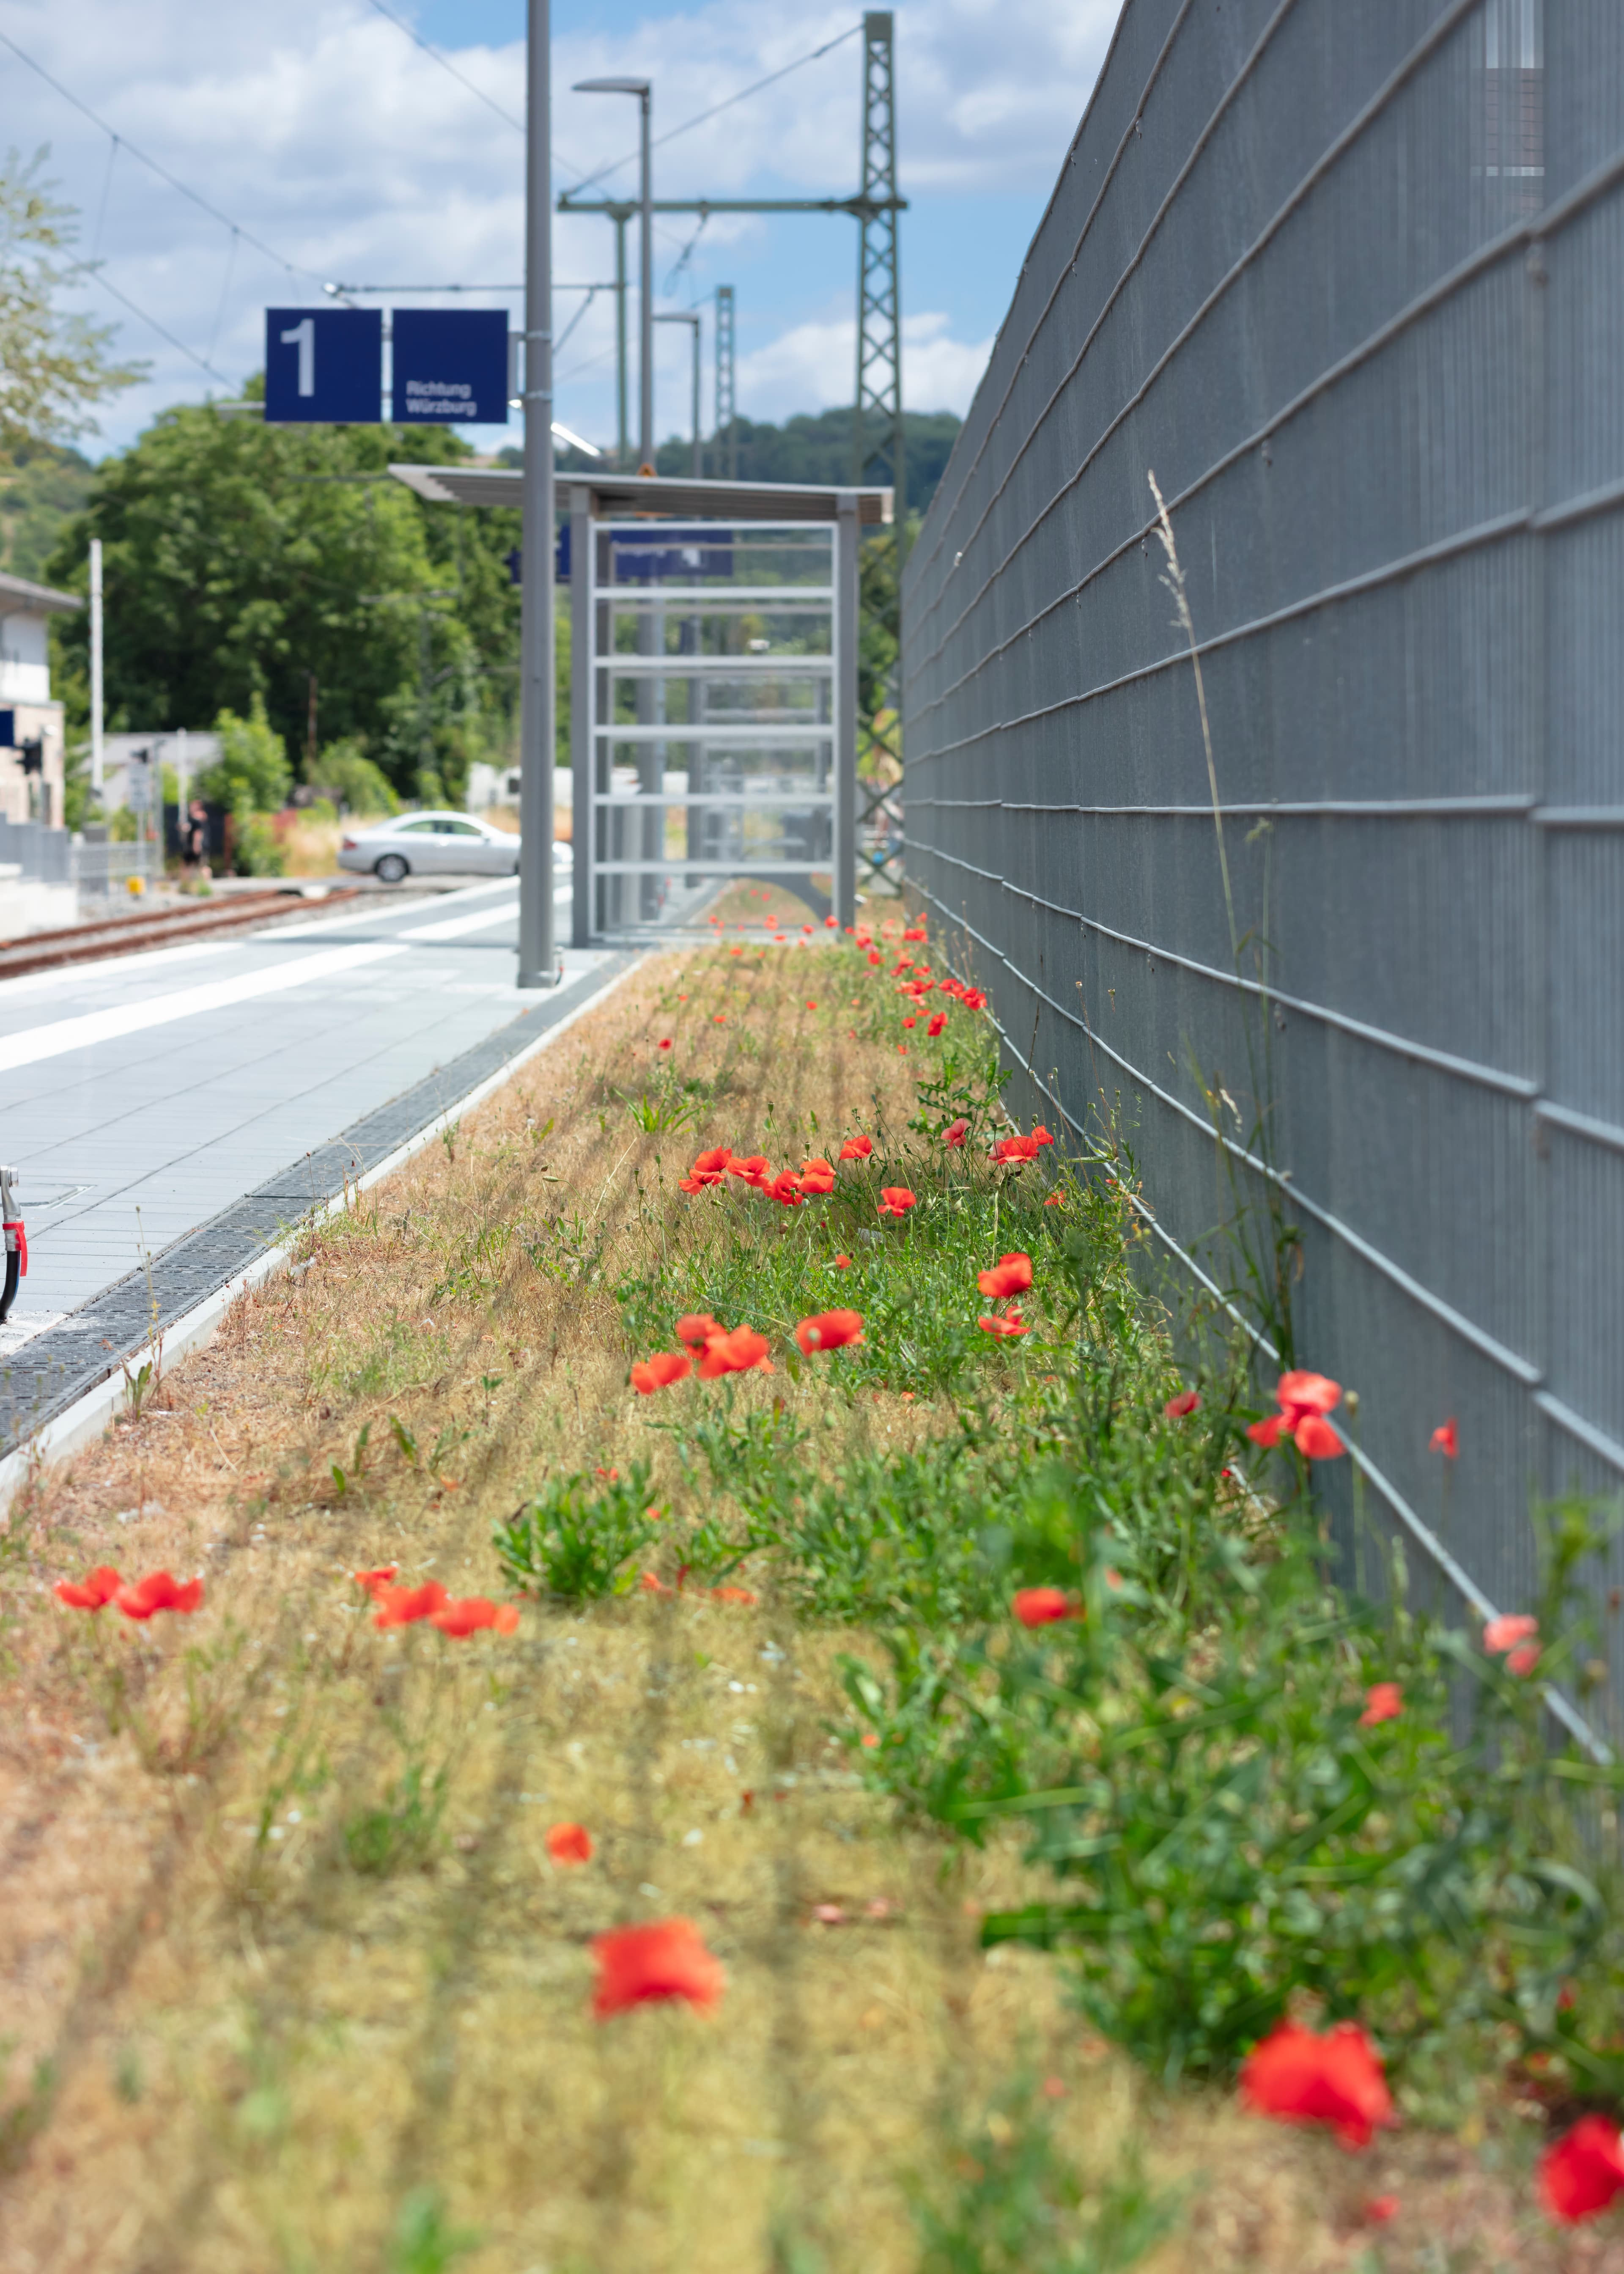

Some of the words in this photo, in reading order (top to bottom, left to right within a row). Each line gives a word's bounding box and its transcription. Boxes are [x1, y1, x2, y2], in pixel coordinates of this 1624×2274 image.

[281, 318, 314, 397] 1
[406, 380, 471, 399] Richtung
[406, 398, 477, 417] Würzburg
